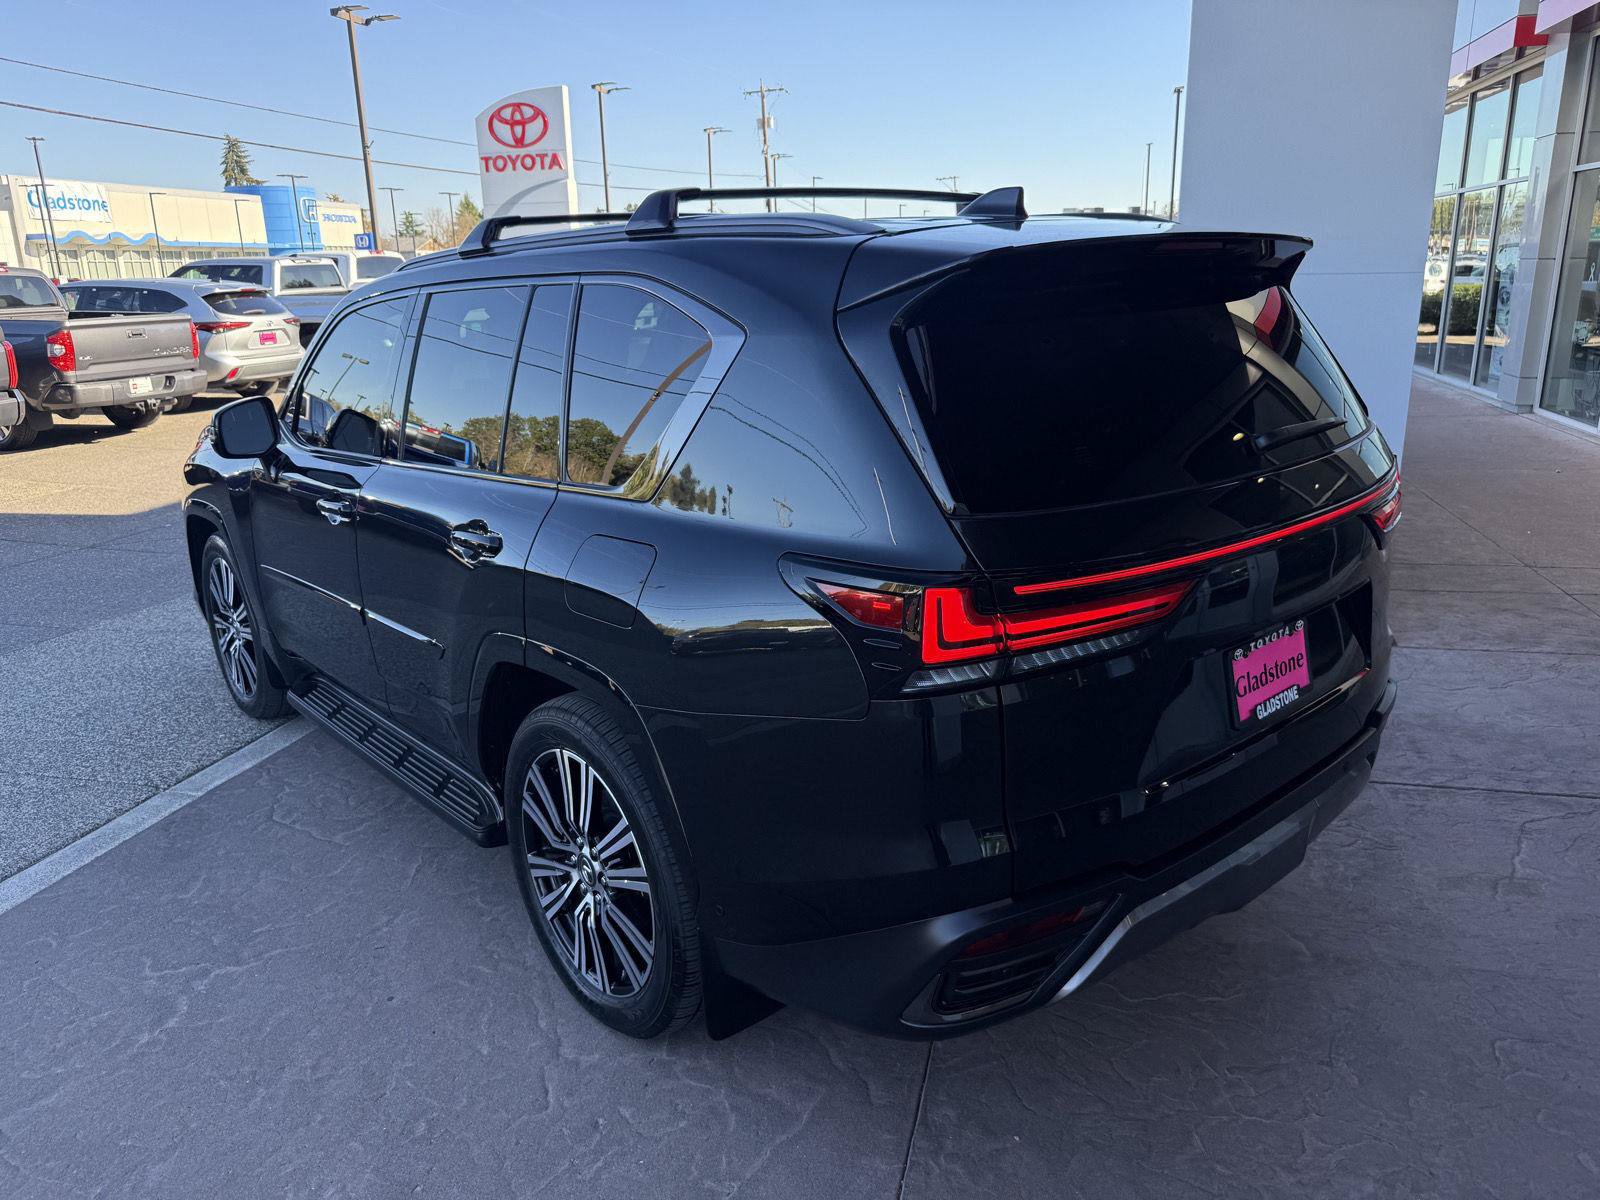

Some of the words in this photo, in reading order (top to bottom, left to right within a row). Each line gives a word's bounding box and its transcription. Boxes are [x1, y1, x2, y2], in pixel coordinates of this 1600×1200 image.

[481, 152, 564, 173] TOYOTA
[1249, 626, 1290, 652] TOYOTA
[1236, 652, 1304, 697] Gladstone
[1256, 685, 1299, 719] GLADSTONE
